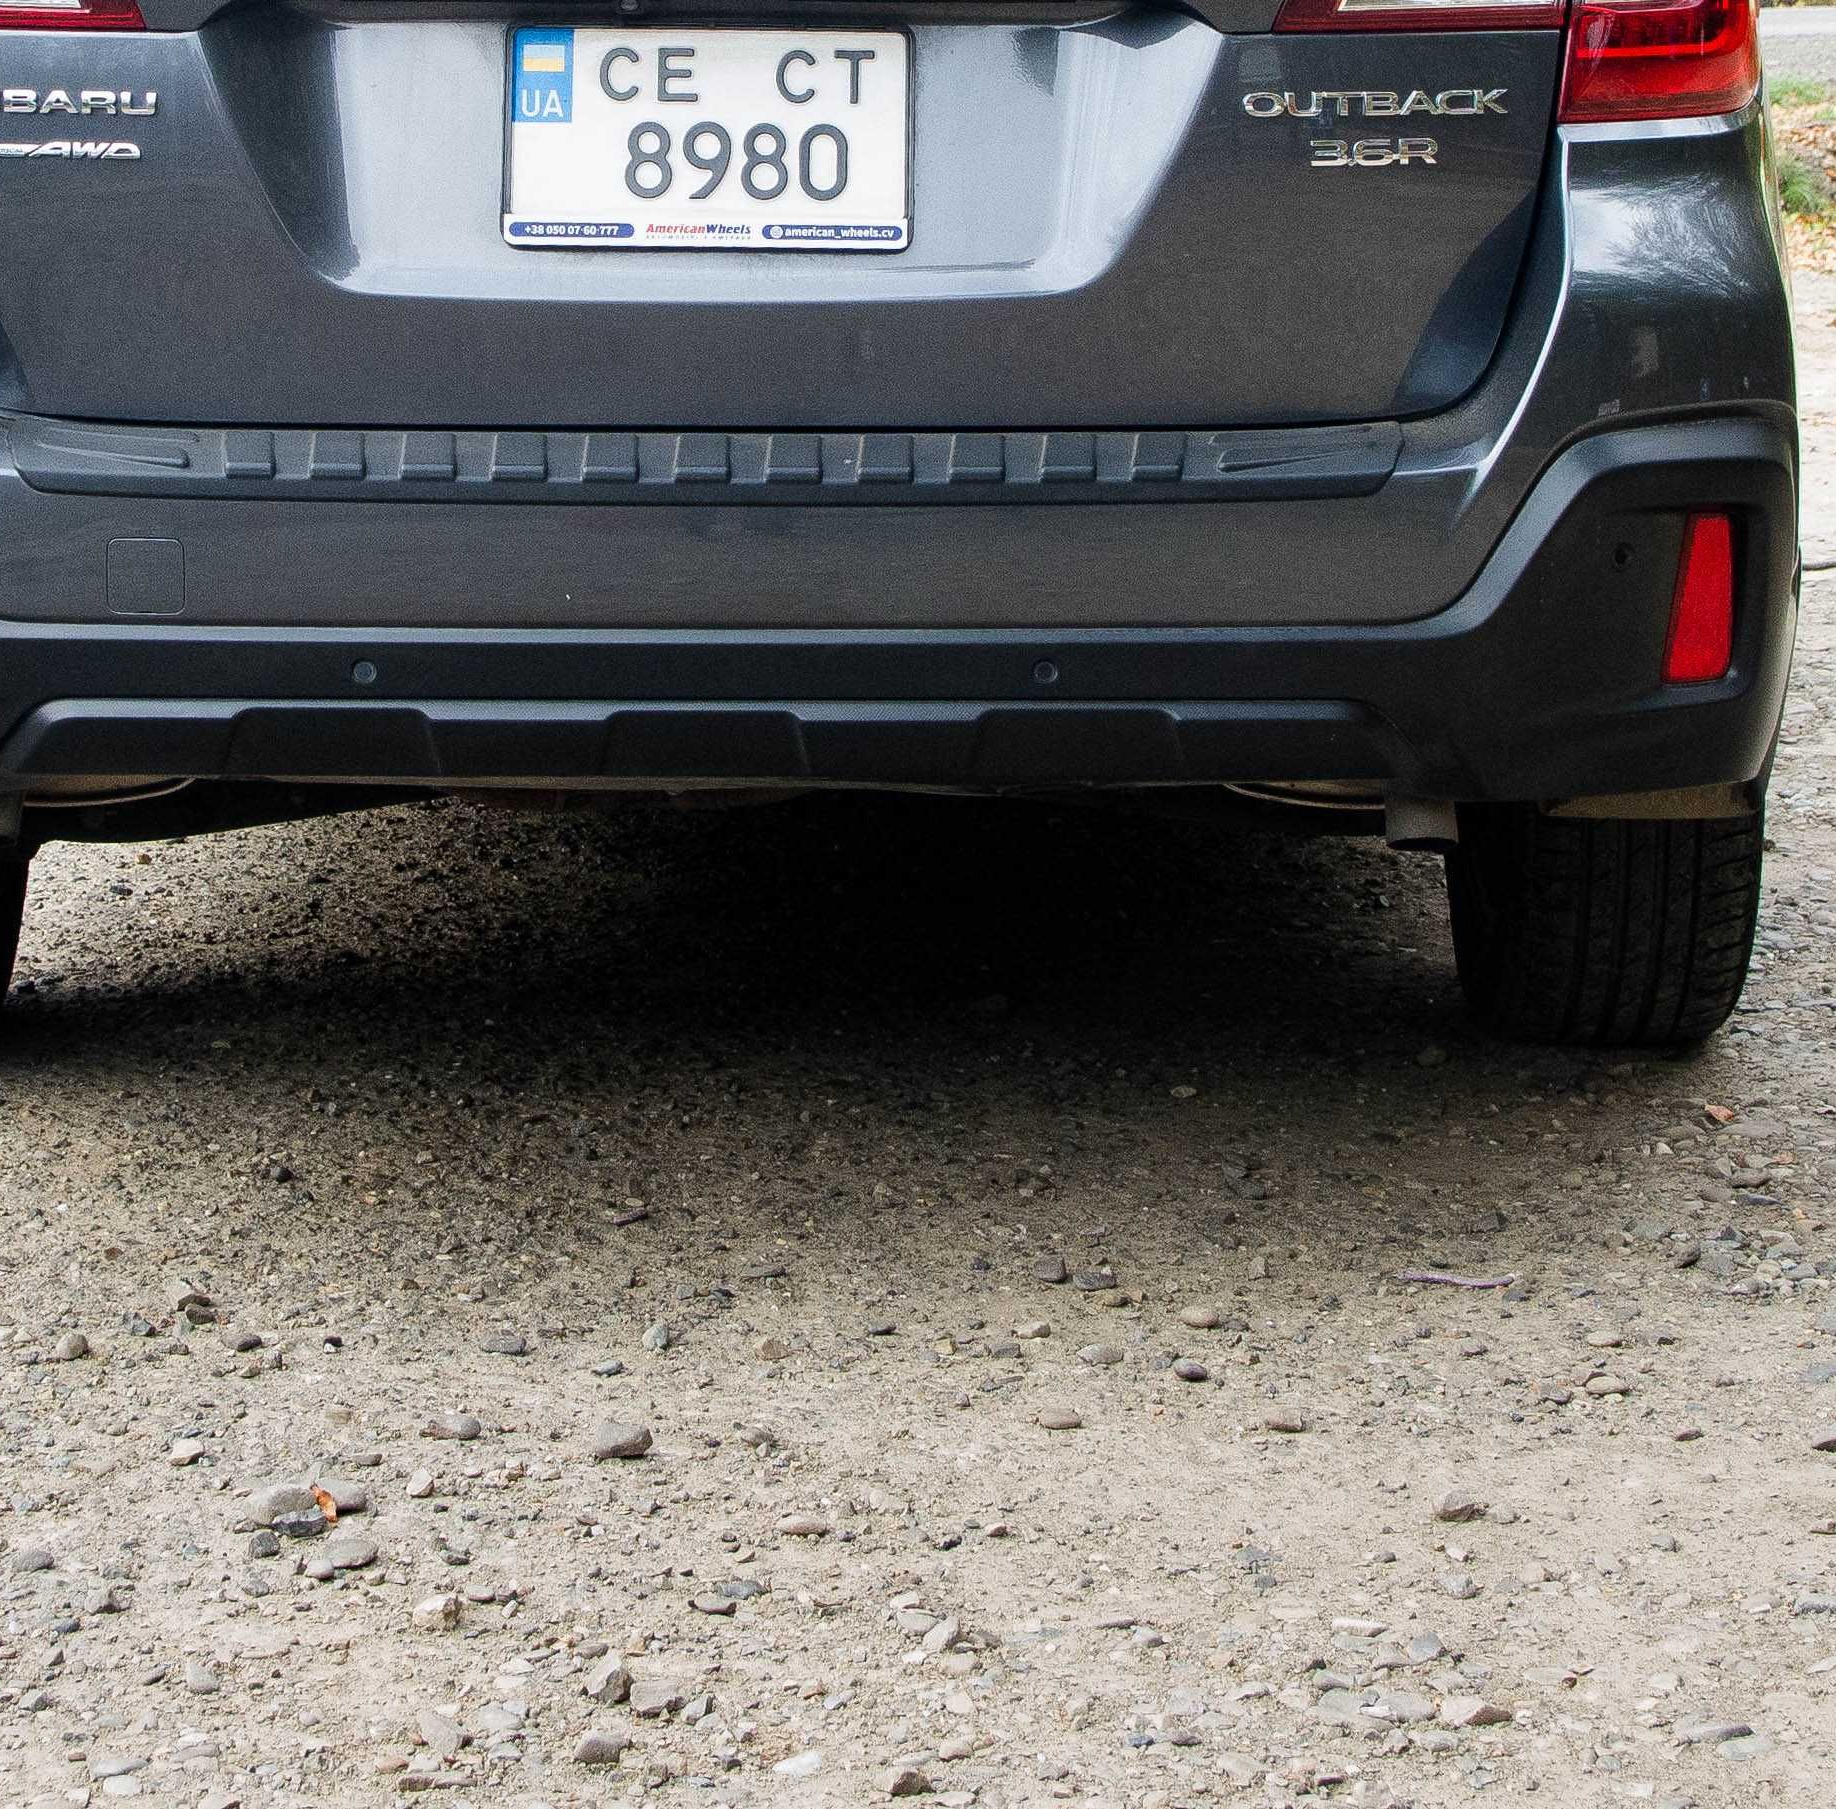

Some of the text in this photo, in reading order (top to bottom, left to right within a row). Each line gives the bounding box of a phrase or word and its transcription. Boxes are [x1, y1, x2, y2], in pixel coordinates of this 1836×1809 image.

[599, 47, 875, 105] CE CT
[521, 89, 564, 118] UA
[1242, 89, 1509, 117] OUTBACK
[28, 141, 141, 160] AWD
[625, 121, 848, 202] 8980
[1311, 137, 1438, 167] 3.6R
[524, 224, 544, 235] +38
[546, 225, 566, 235] 050
[784, 226, 894, 239] american_wheels.cv
